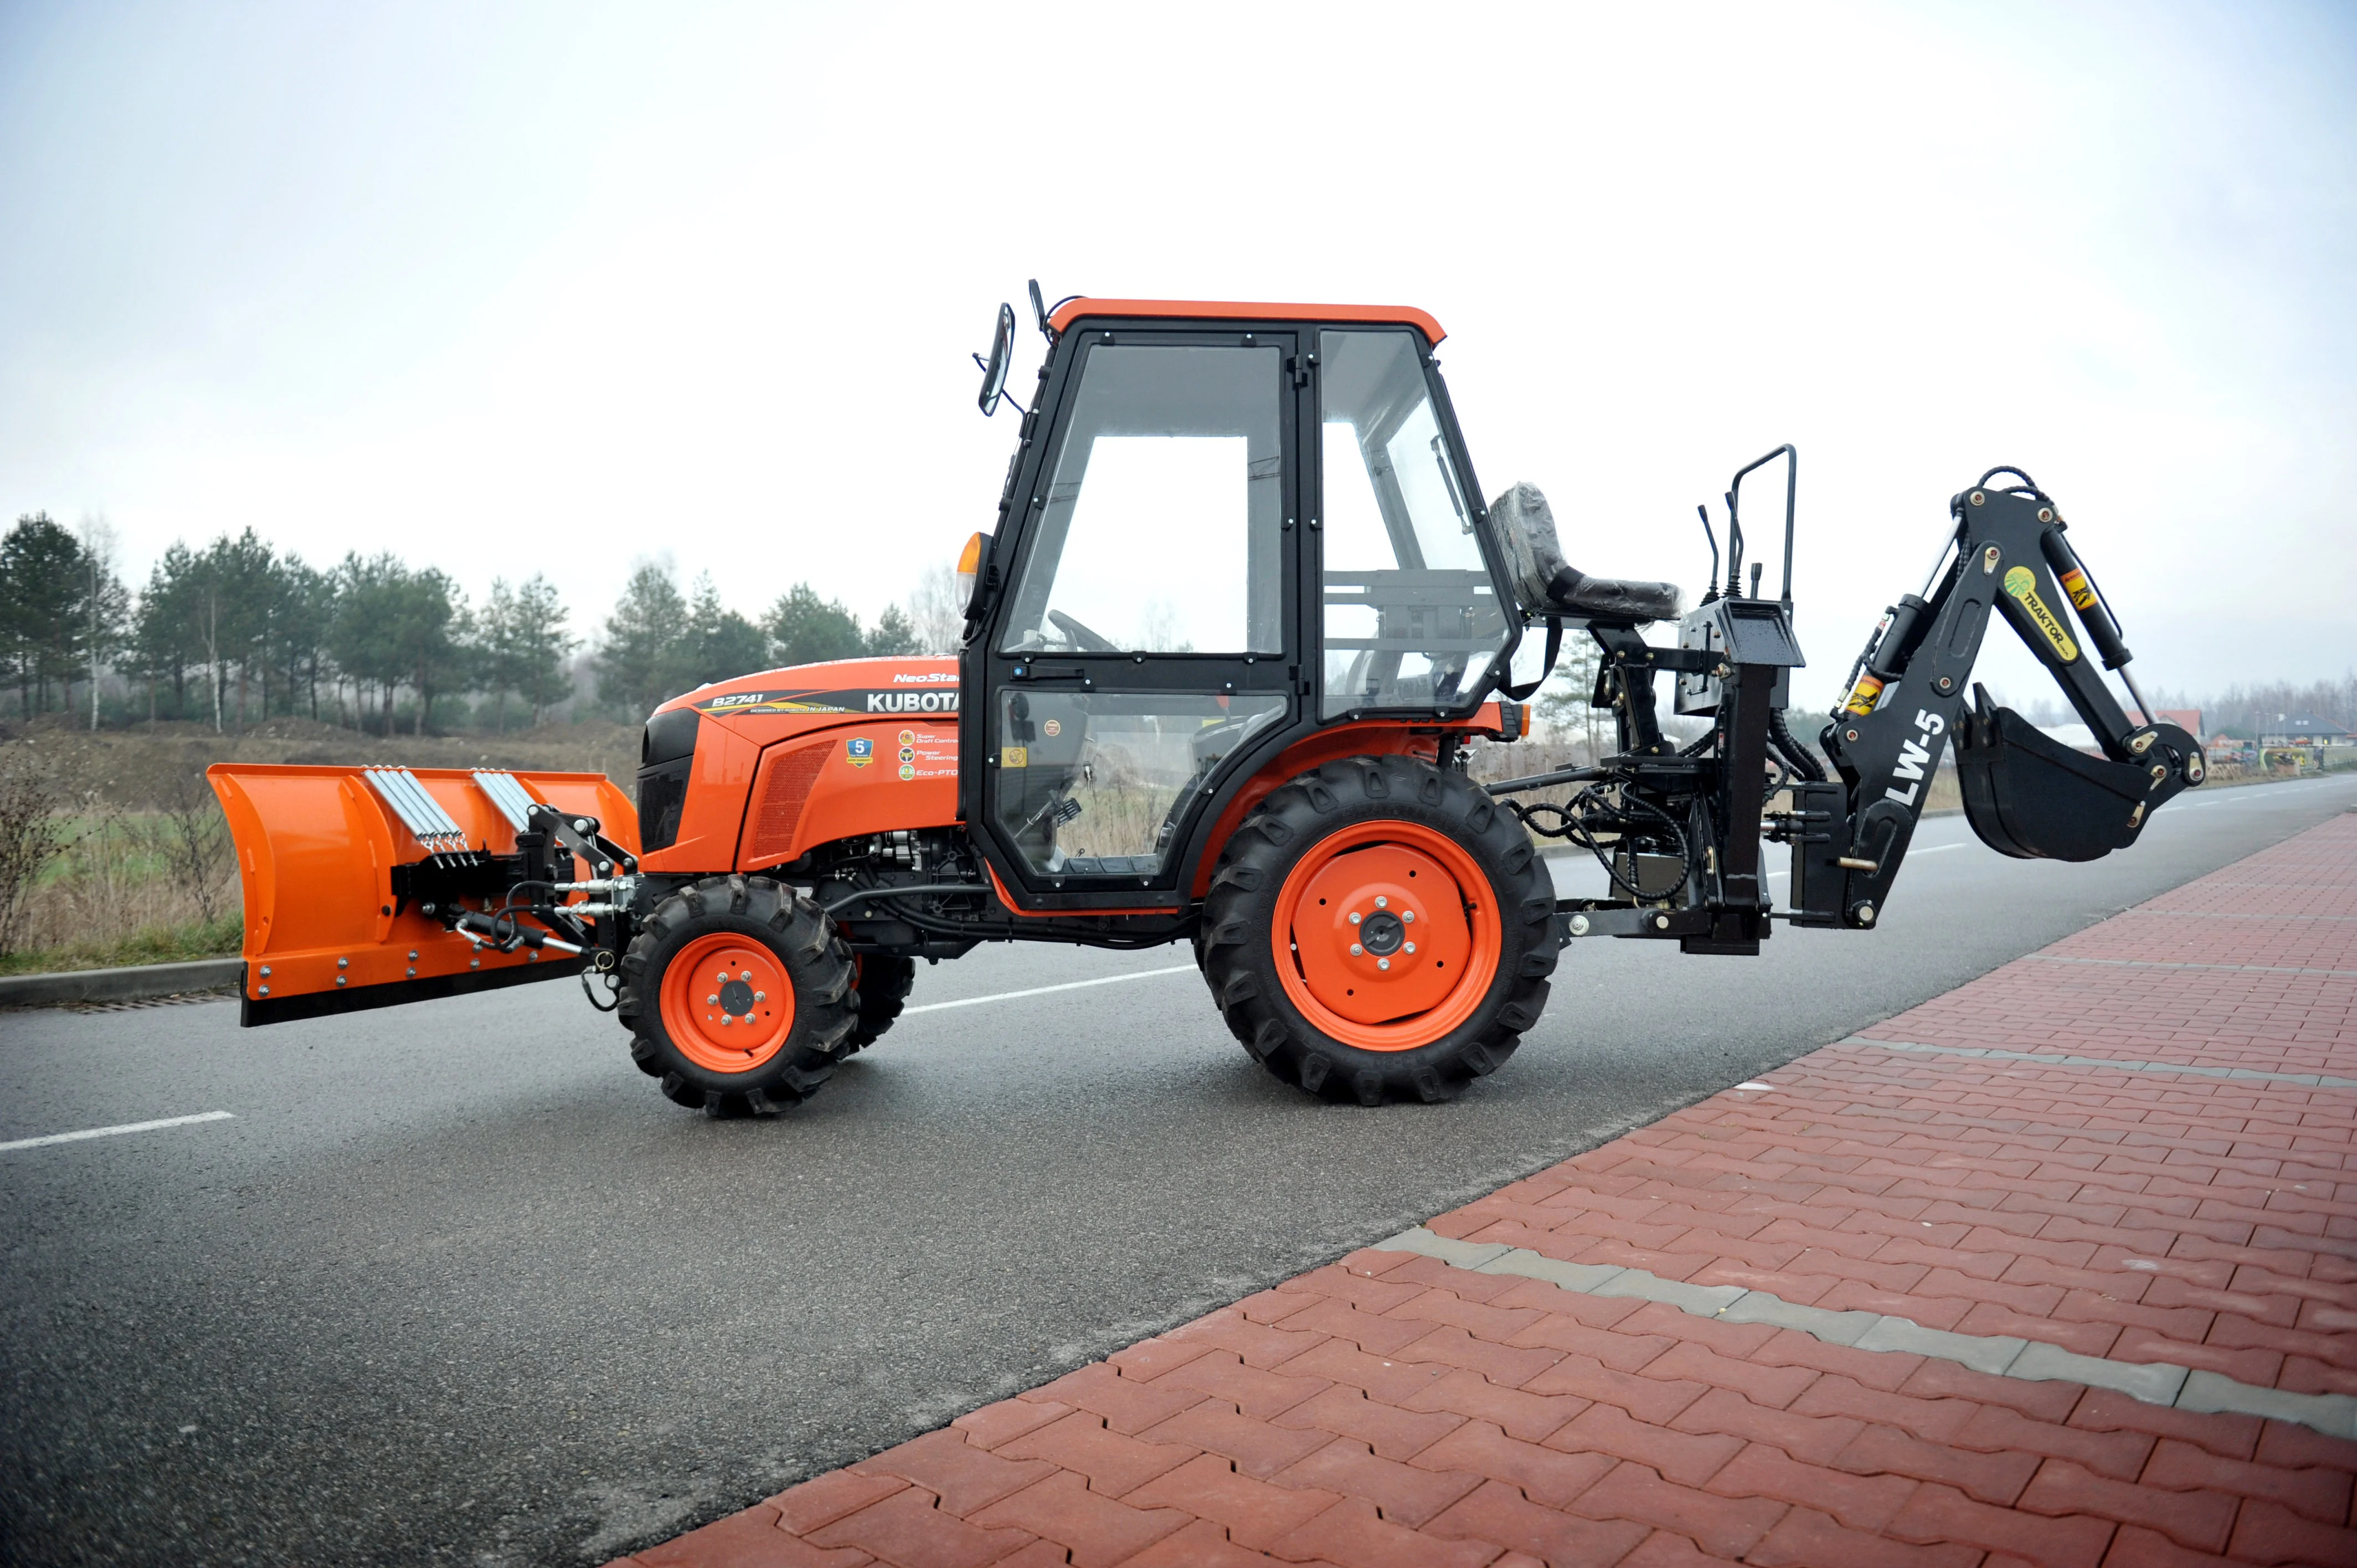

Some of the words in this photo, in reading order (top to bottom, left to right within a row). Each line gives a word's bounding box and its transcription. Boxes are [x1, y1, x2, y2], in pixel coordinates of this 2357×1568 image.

[712, 694, 763, 708] B2741
[855, 741, 864, 754] 5
[1885, 709, 1944, 806] LW-5
